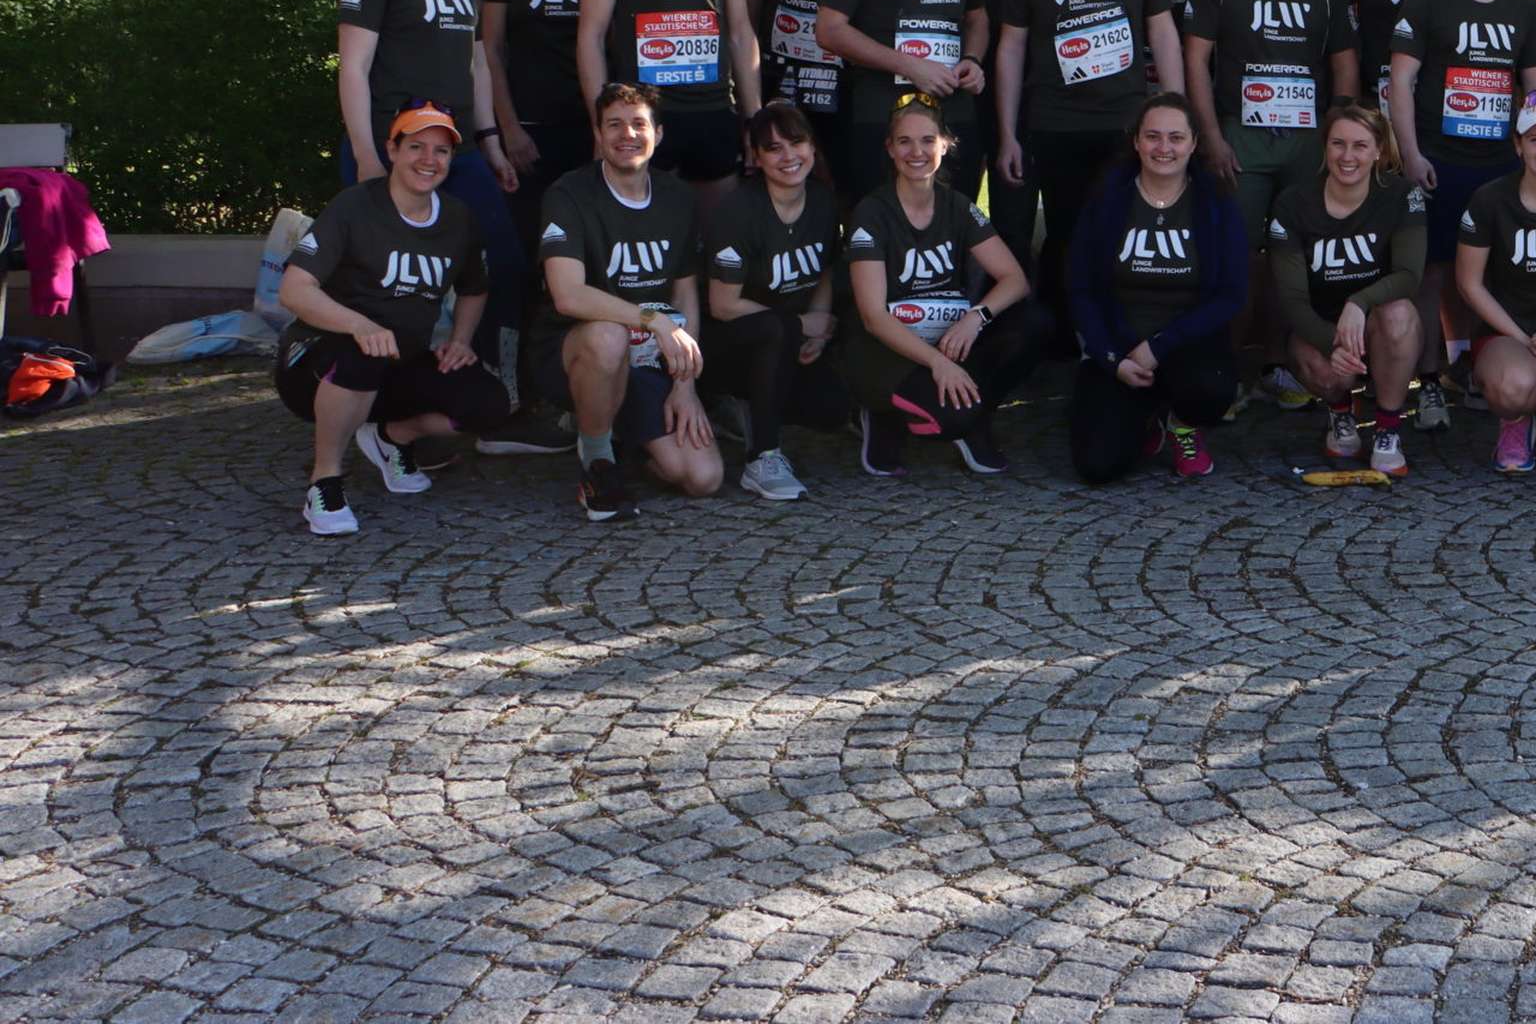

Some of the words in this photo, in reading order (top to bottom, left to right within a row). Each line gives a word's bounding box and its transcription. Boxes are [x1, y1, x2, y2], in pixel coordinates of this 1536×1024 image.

[662, 13, 698, 21] WIENER
[1092, 28, 1129, 48] 2162C
[676, 39, 717, 56] 20836
[656, 71, 692, 82] ERSTE
[1471, 70, 1502, 79] WIENER
[1277, 86, 1313, 99] 2154C
[803, 93, 831, 104] 2162
[1457, 124, 1492, 136] ERSTE
